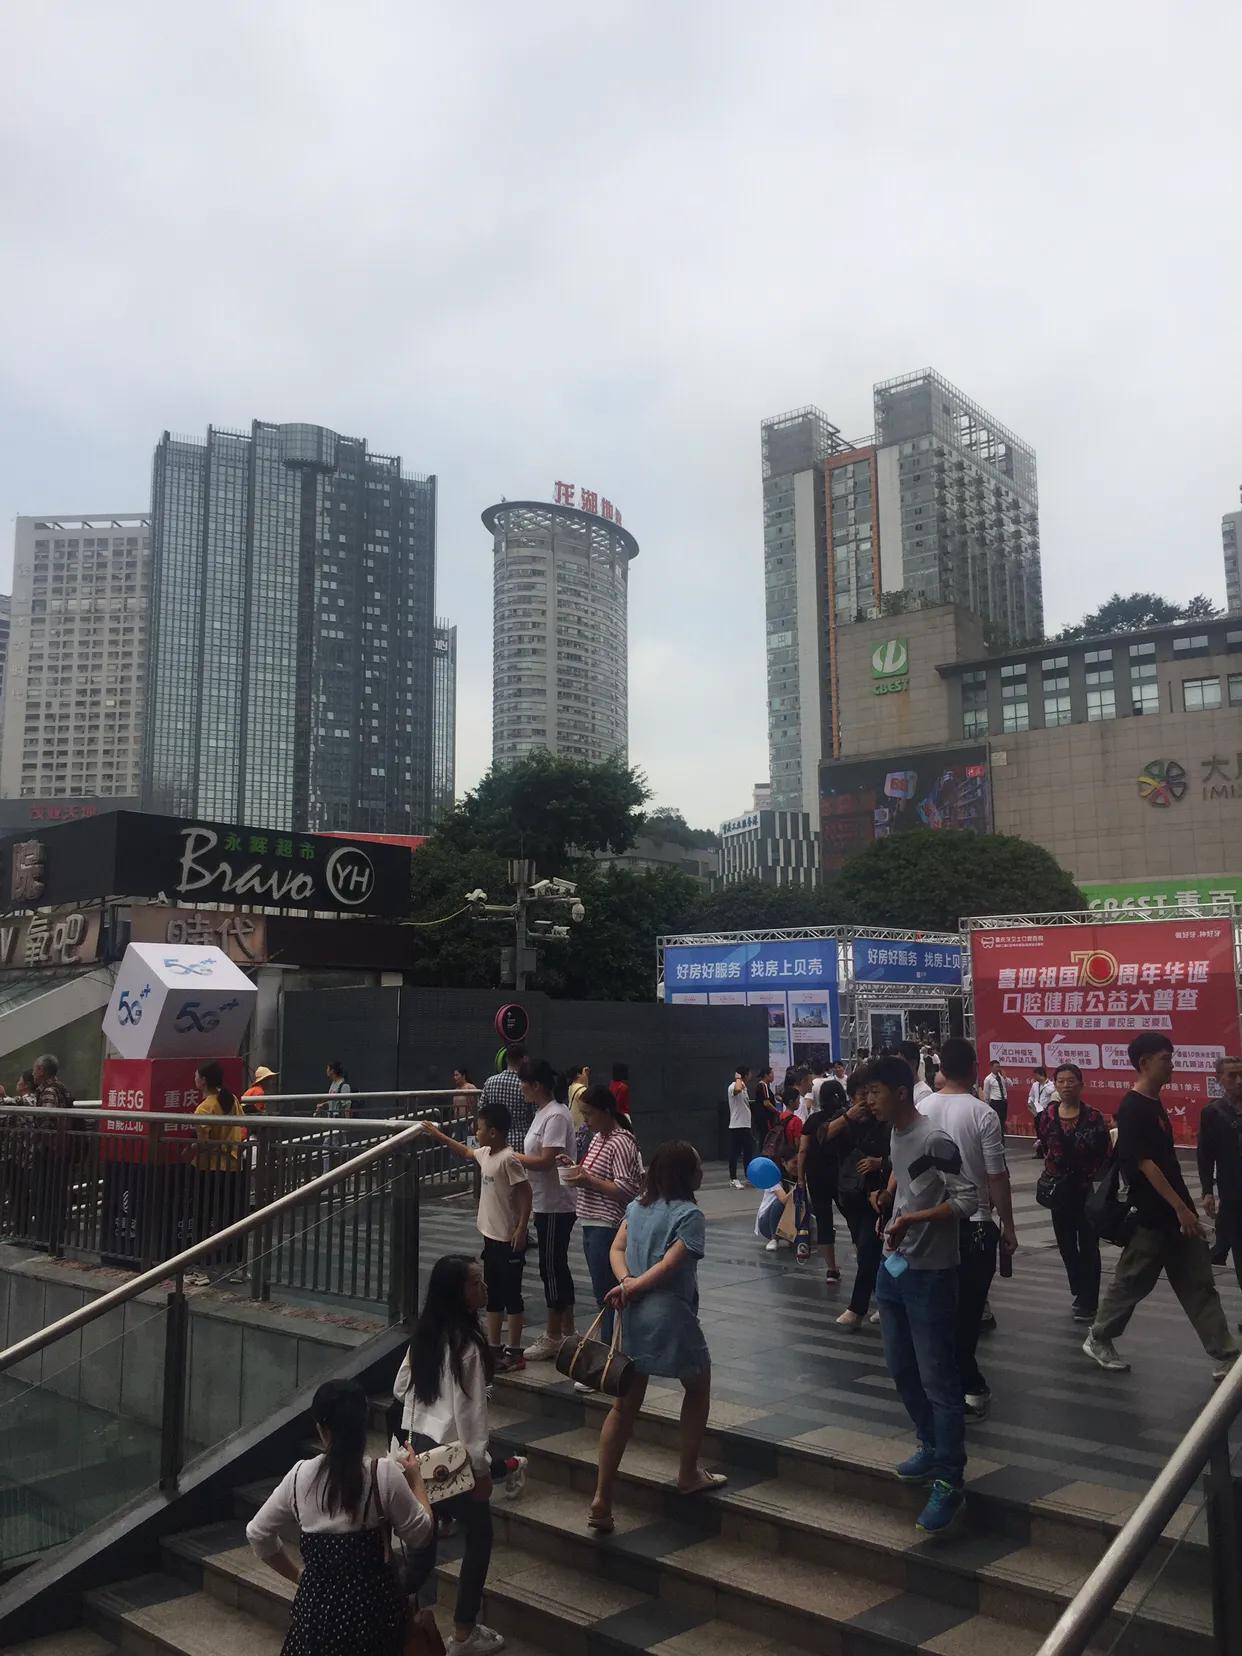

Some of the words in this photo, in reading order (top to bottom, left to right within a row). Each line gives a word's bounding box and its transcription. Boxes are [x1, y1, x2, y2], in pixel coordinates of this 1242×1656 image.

[176, 827, 316, 901] Bravo
[677, 961, 741, 980] 好房好服务
[751, 958, 823, 978] 找房上贝壳
[868, 948, 918, 967] 好房好服务
[998, 949, 1210, 989] 喜迎祖国70周年华诞
[1003, 989, 1199, 1013] 口腔健康公益大普查
[108, 1089, 145, 1109] 重庆5G
